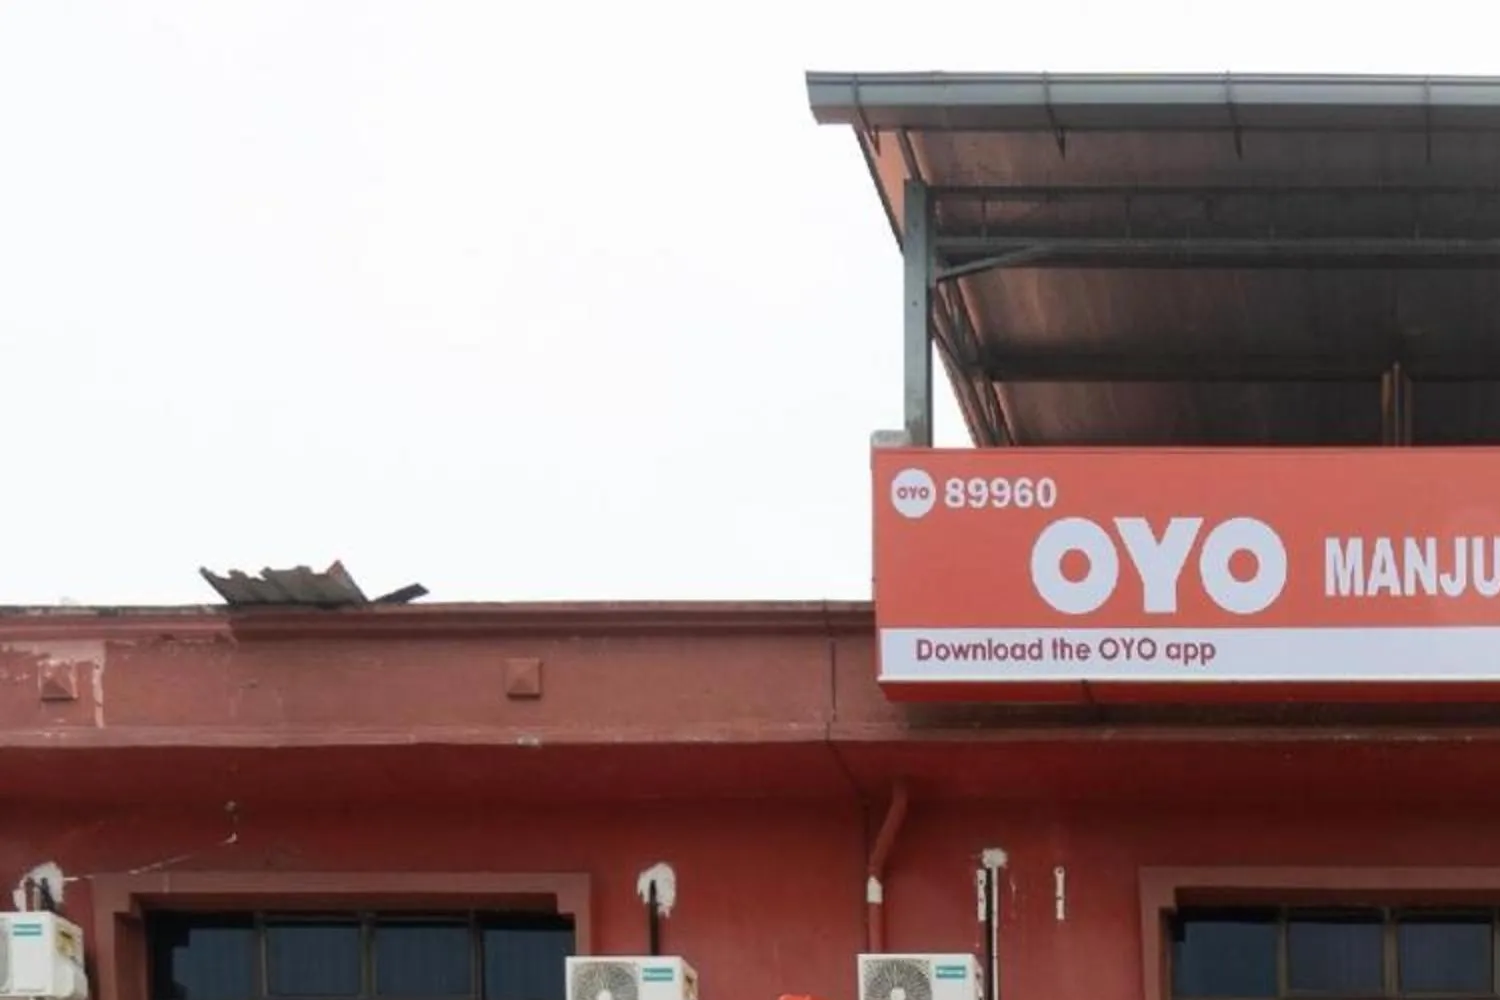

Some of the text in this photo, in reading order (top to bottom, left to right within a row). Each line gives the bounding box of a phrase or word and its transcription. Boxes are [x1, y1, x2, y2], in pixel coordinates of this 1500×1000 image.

[897, 487, 930, 500] OYO
[945, 477, 1057, 509] 89960
[1031, 517, 1287, 614] OYO
[916, 637, 1216, 666] Download the OYO app
